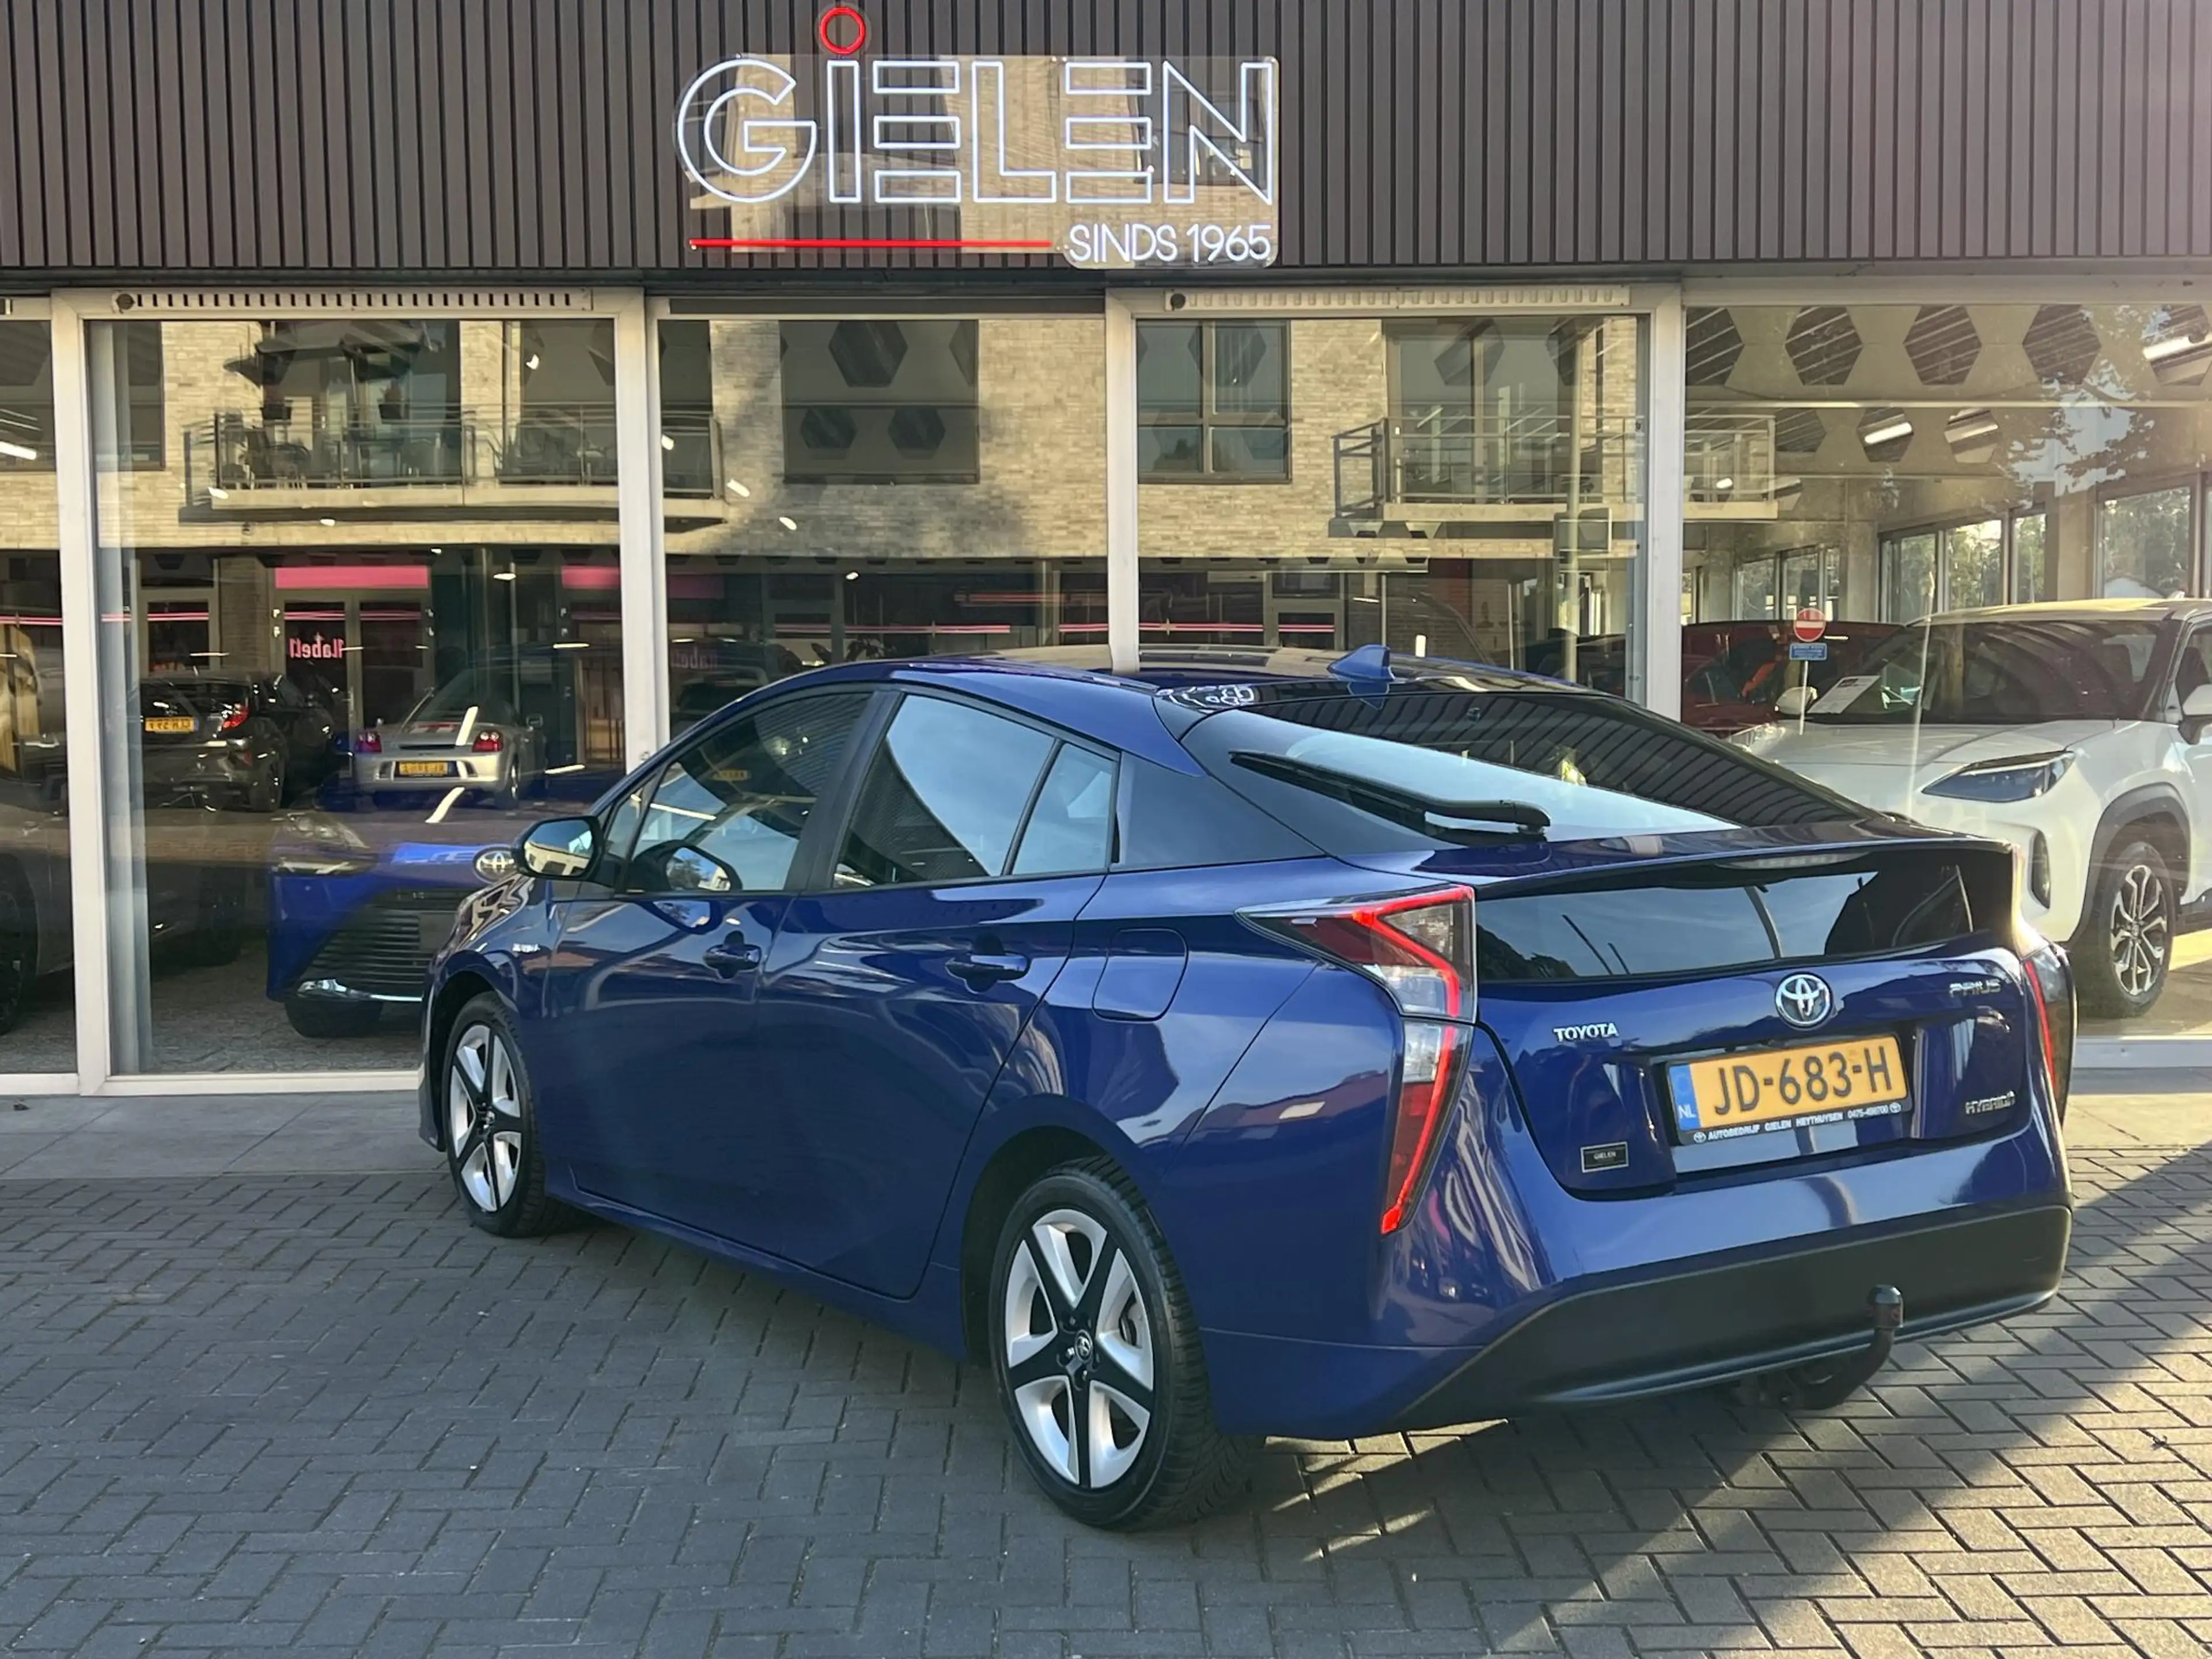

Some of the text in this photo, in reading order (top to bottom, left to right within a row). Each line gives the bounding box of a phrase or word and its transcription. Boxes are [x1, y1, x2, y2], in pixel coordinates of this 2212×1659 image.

[1069, 222, 1271, 263] SINDS 1965
[1949, 979, 2001, 998] PRIUS
[1553, 1022, 1620, 1042] TOYOTA
[1714, 1045, 1893, 1116] JD-683-H
[1677, 1104, 1696, 1119] NL
[1707, 1125, 1760, 1141] AUTOBEDRIJF
[1764, 1119, 1791, 1132] GIELEN
[1796, 1112, 1844, 1127] HEYTHUYSEN
